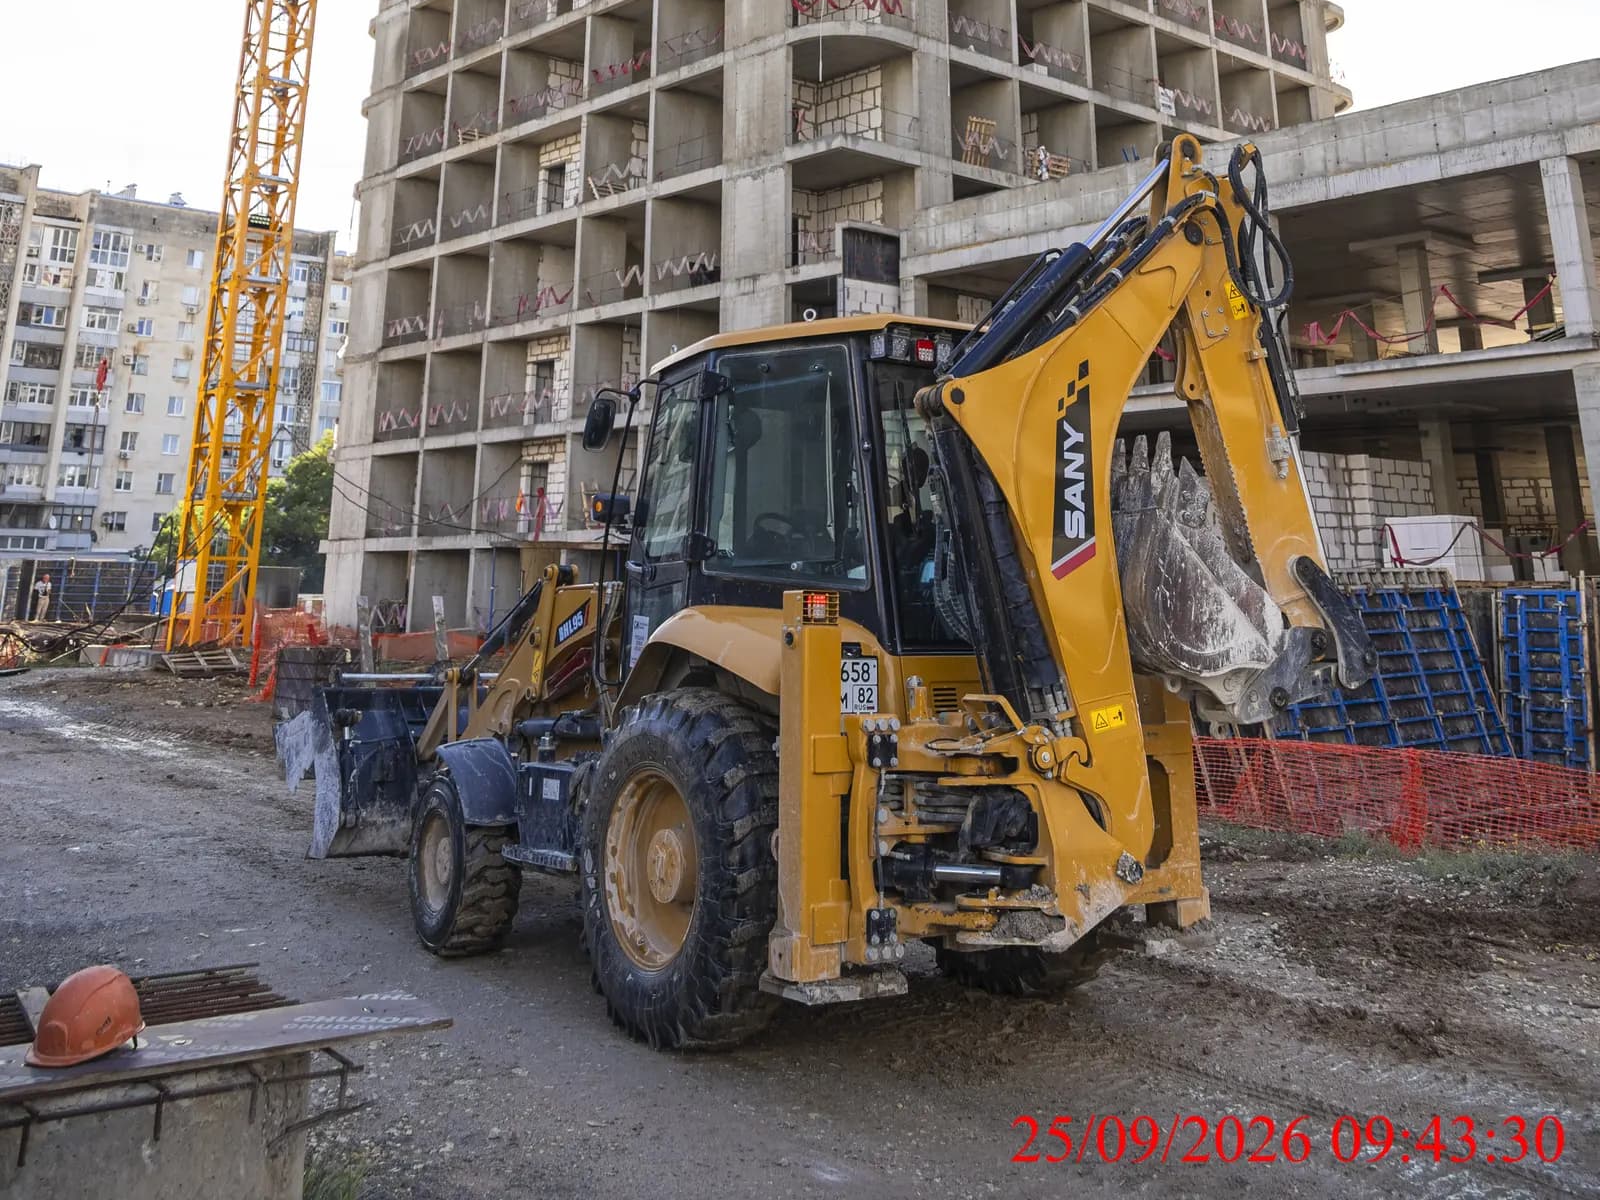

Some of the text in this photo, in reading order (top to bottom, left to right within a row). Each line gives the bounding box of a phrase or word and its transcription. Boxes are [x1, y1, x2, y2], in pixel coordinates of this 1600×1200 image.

[1063, 420, 1085, 539] SANY
[841, 662, 870, 682] 658
[858, 687, 873, 704] 82
[854, 703, 866, 711] RUS
